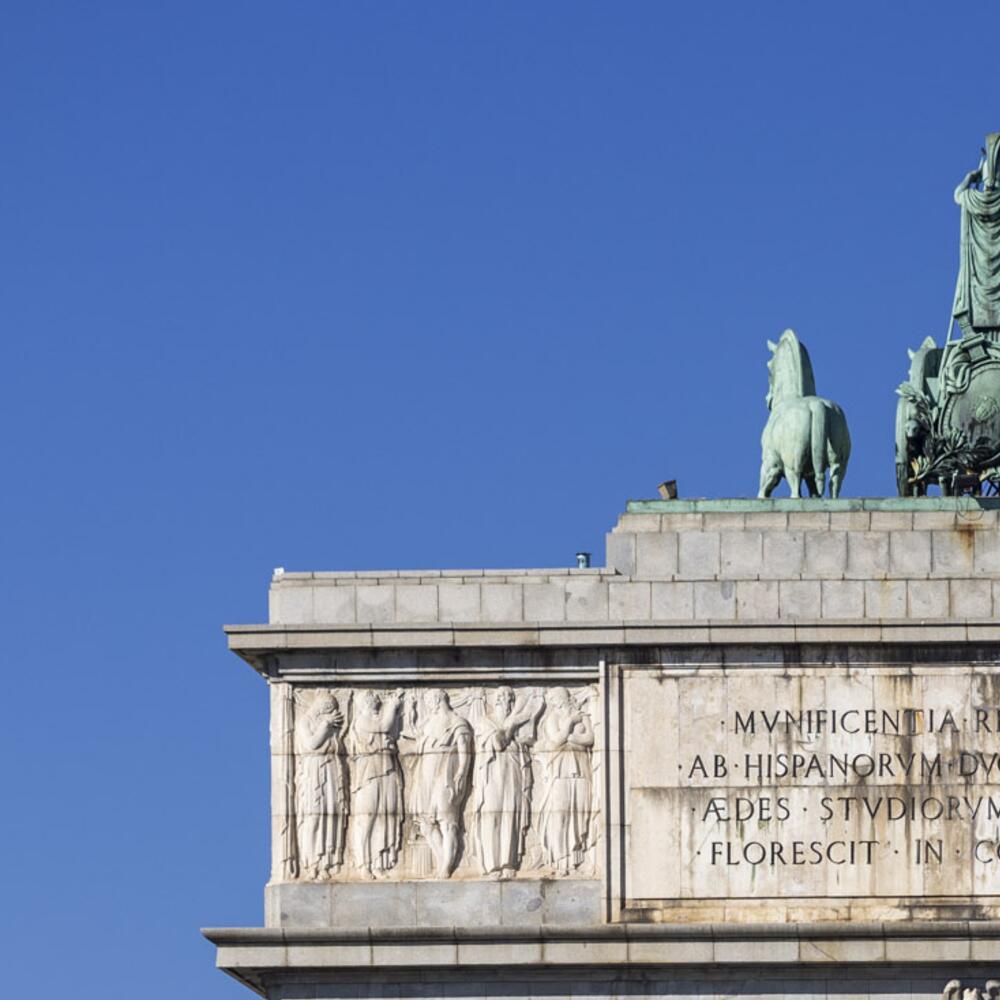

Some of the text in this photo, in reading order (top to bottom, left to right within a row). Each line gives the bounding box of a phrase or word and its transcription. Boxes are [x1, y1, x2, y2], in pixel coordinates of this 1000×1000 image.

[734, 709, 960, 735] MVNIFICENTIA
[688, 754, 729, 779] AB
[744, 753, 942, 779] HISPANORVM
[701, 797, 791, 822] ÆDES
[710, 841, 880, 866] FLORESCIT
[915, 839, 943, 865] IN
